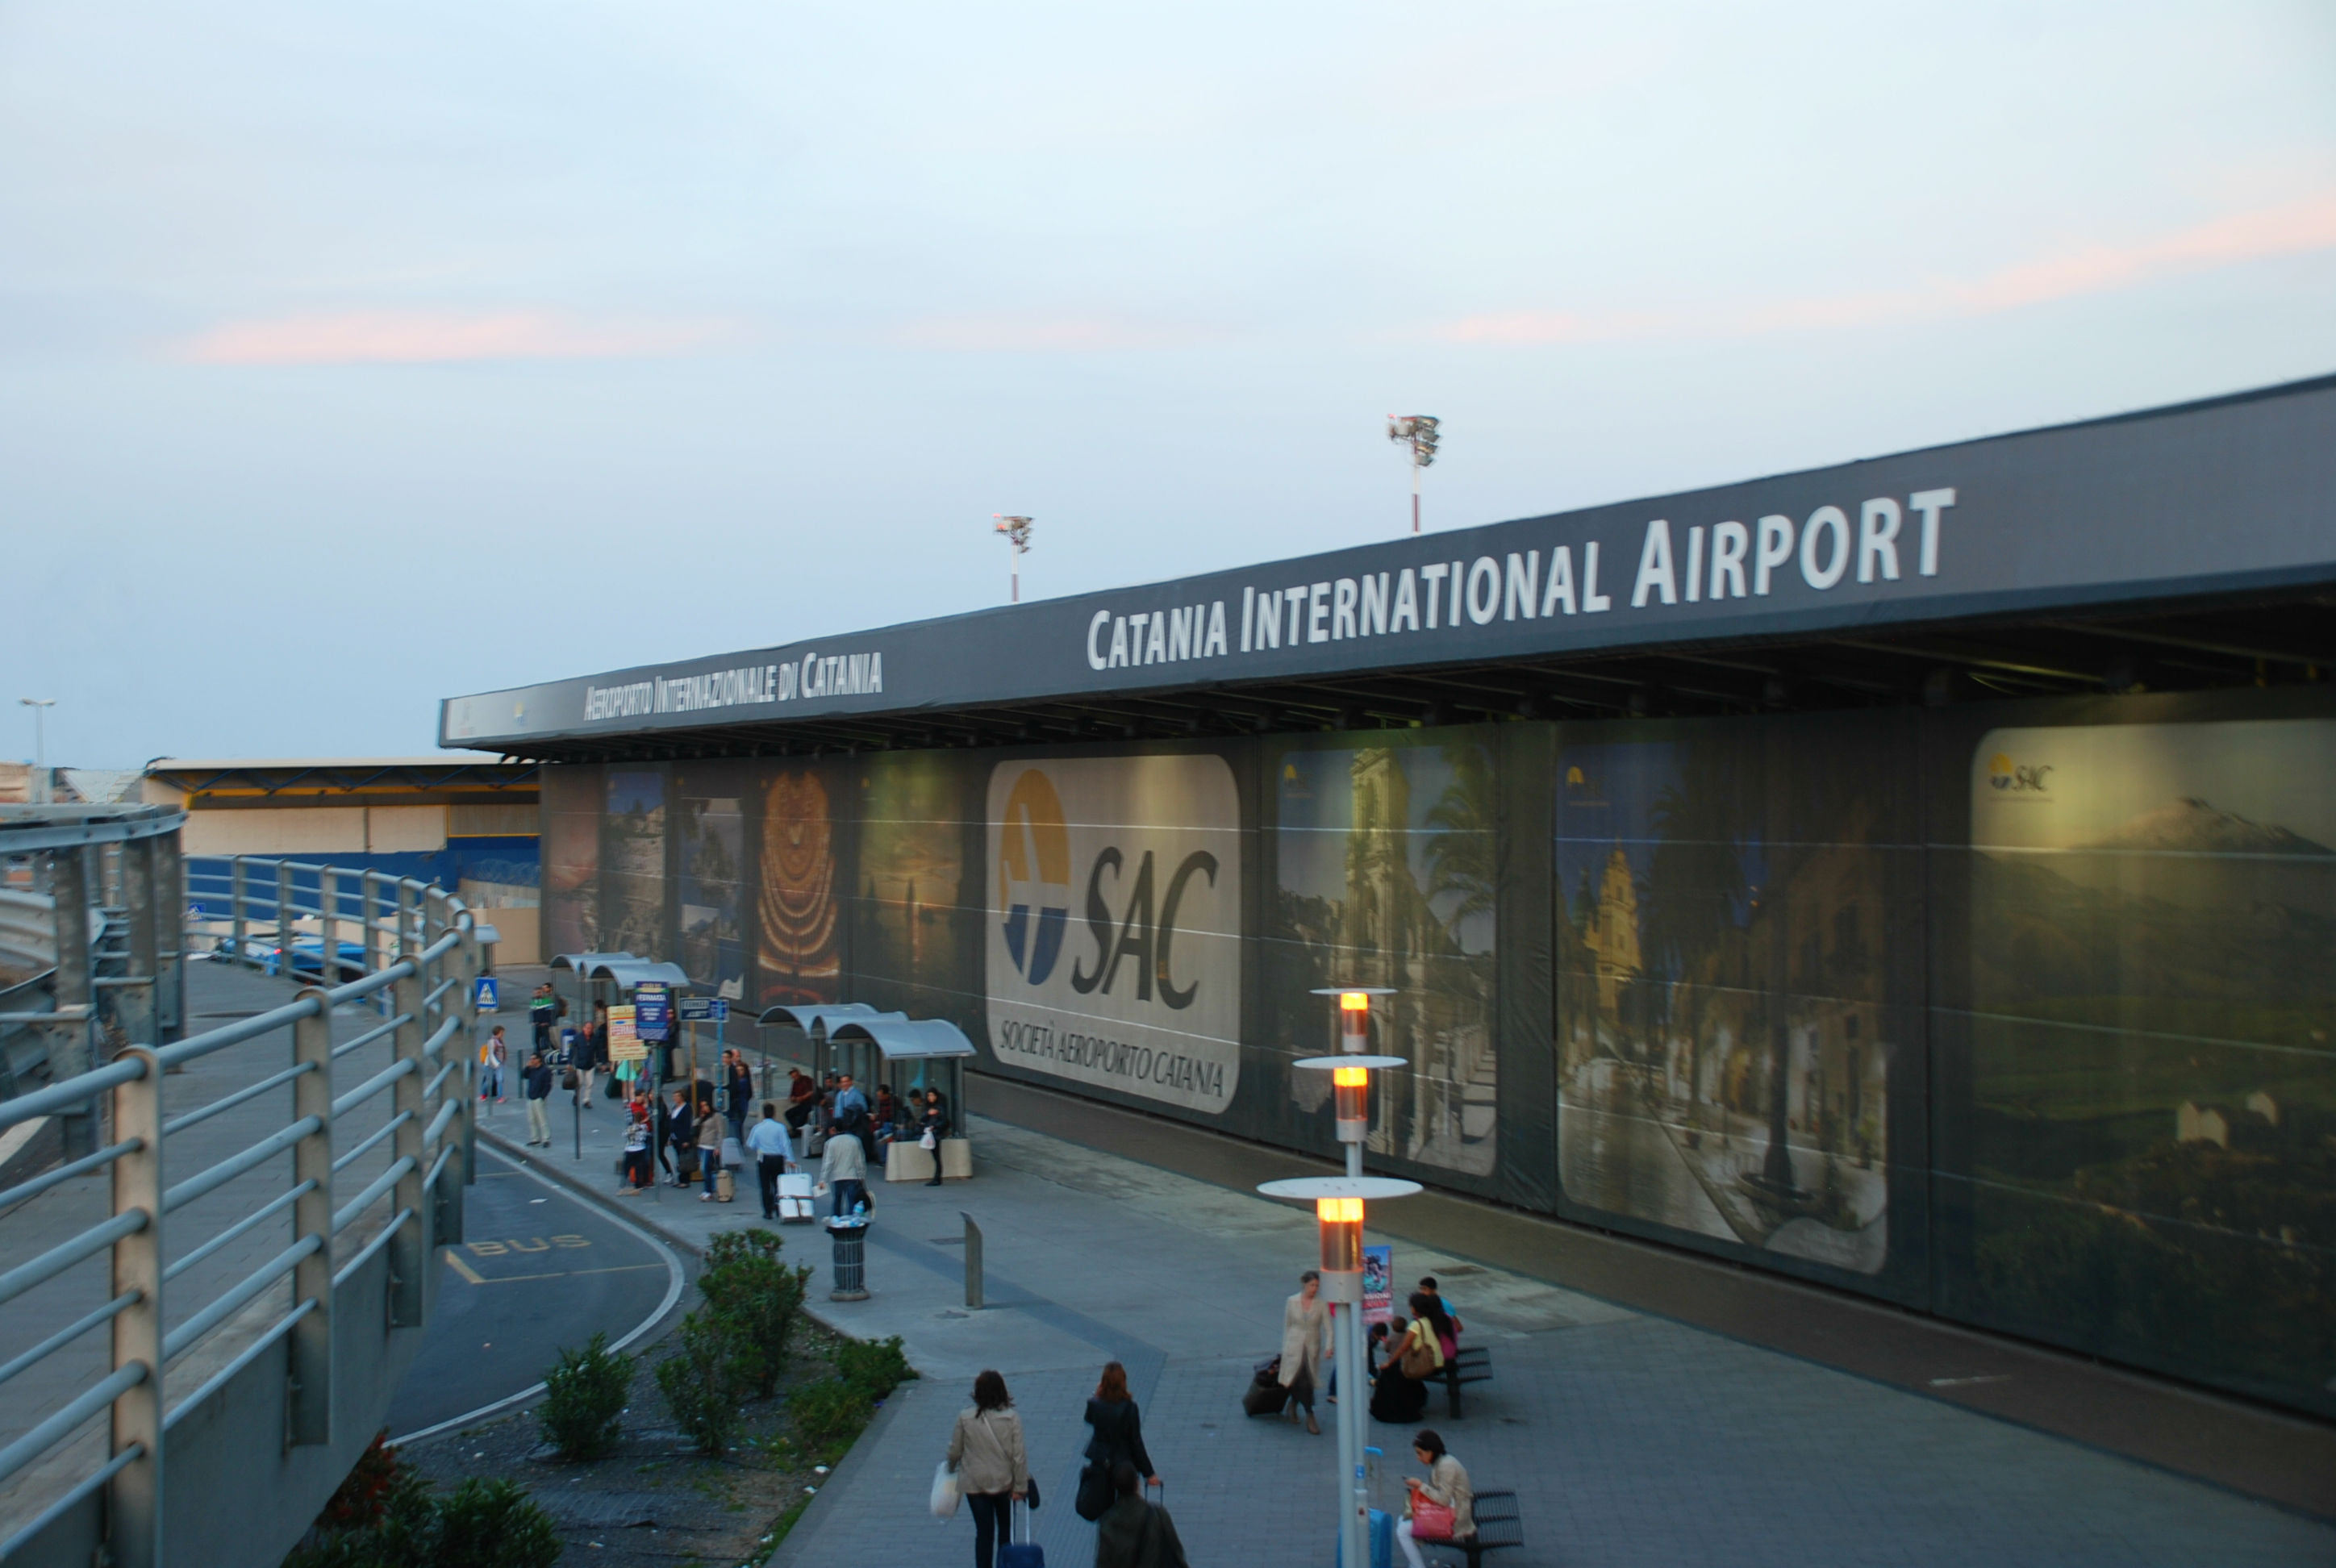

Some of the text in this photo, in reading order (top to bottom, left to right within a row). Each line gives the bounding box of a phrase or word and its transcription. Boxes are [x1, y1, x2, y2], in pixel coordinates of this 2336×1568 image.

[1087, 487, 1956, 670] CATANIA INTERNATIONAL AIRPORT
[584, 682, 654, 720] AEROPORTO
[653, 665, 777, 713] INTERNAZIONALE
[801, 652, 882, 699] CATANIA
[1071, 846, 1219, 1010] SAC
[1057, 1033, 1153, 1080] AEROPORTO
[1153, 1051, 1224, 1098] CATANIA
[467, 1234, 593, 1257] BUS
